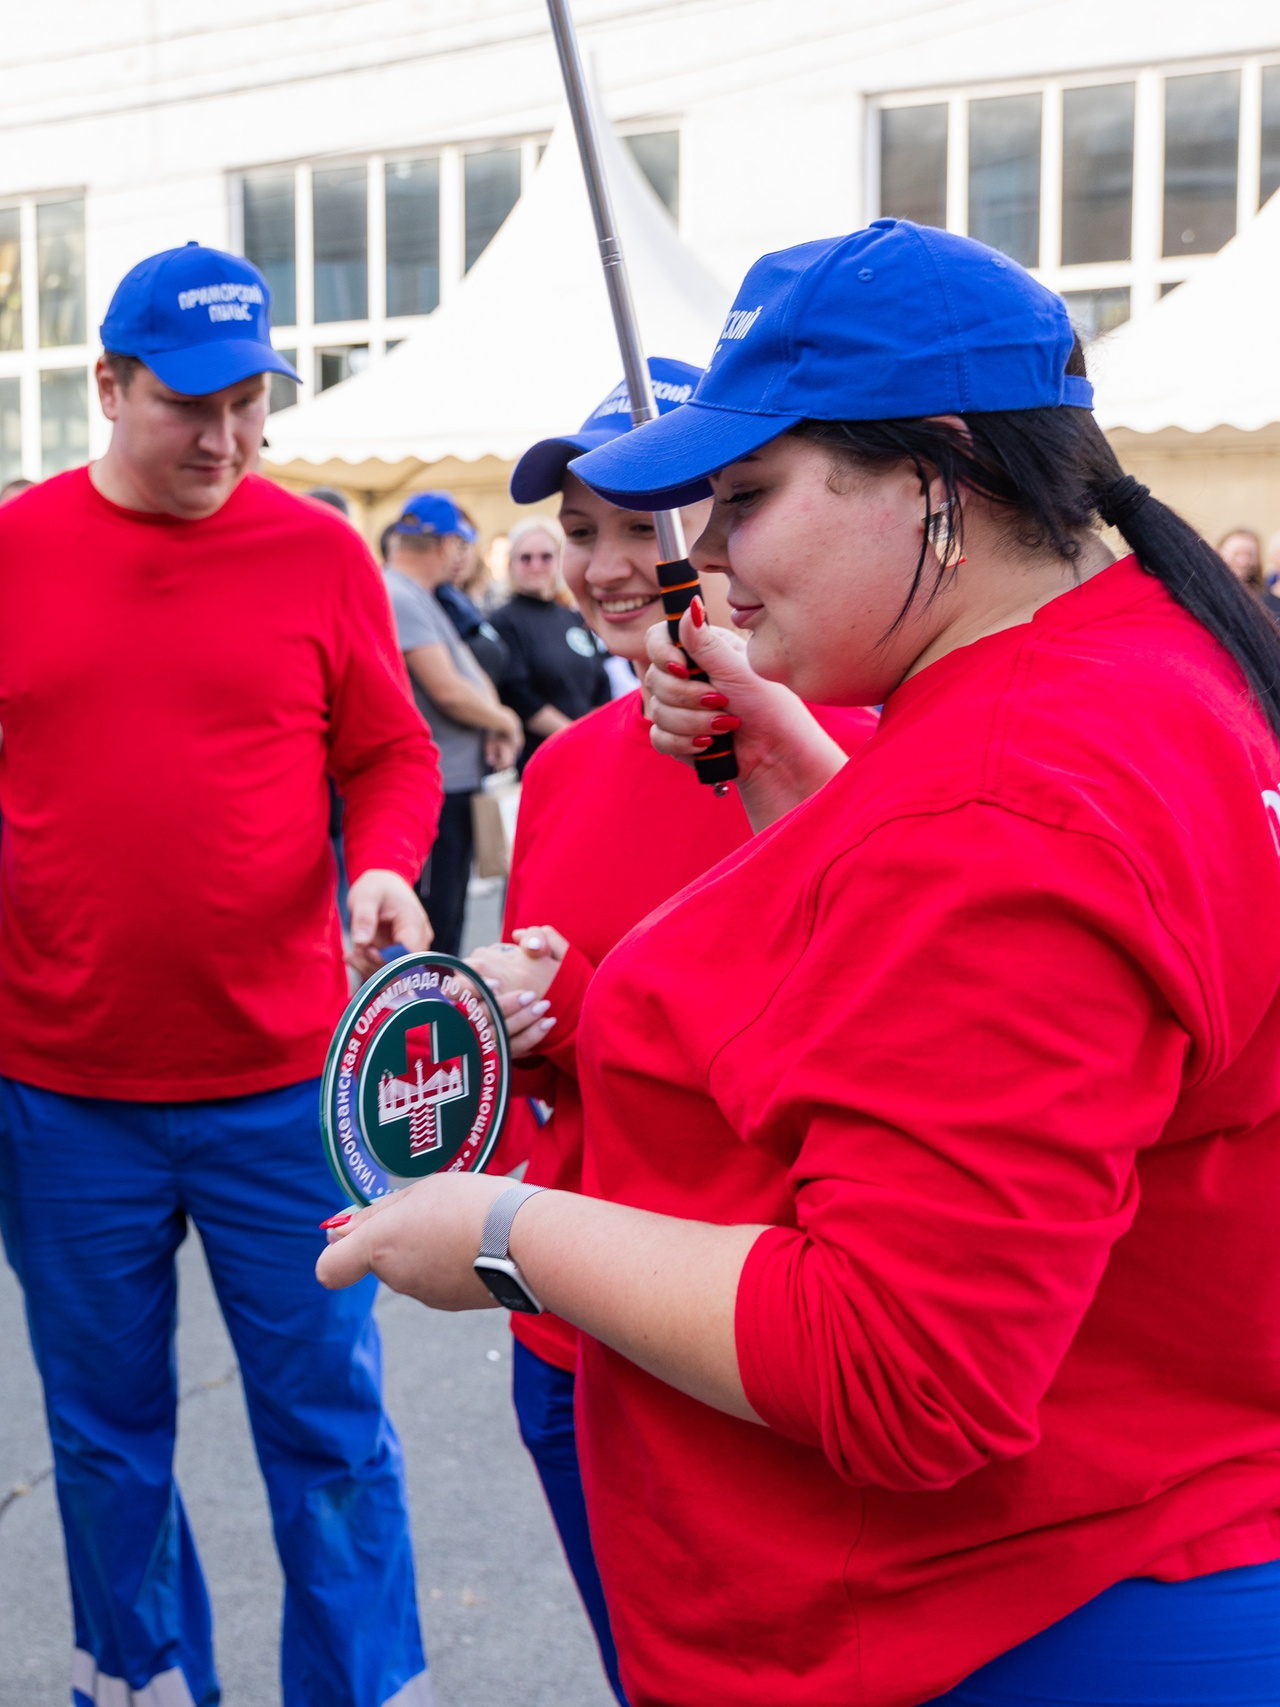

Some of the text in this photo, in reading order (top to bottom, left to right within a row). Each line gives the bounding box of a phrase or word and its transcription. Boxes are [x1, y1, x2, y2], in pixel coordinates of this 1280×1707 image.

[178, 283, 264, 310] ПРИМОРСКИЙ
[207, 302, 253, 323] ПУЛЬС
[337, 971, 497, 1195] Тихоокеанская Олимпиада по первой помощи
